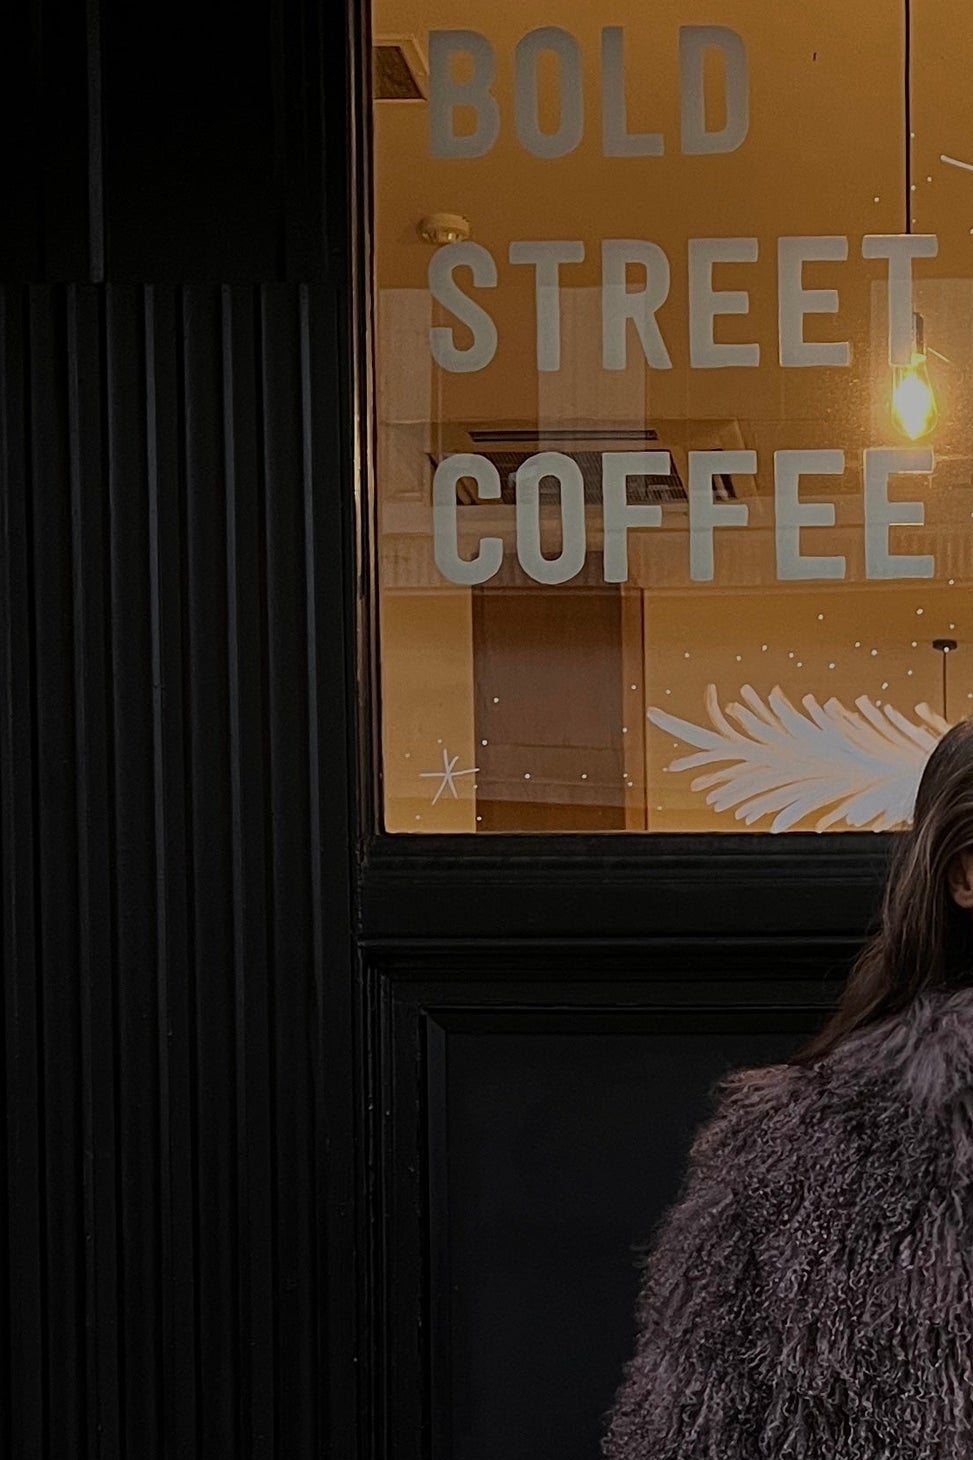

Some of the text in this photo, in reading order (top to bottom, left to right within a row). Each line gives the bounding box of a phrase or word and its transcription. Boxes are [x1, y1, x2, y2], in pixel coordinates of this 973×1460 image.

[428, 25, 750, 159] BOLD
[428, 234, 939, 373] STREET
[432, 448, 935, 585] COFFEE
